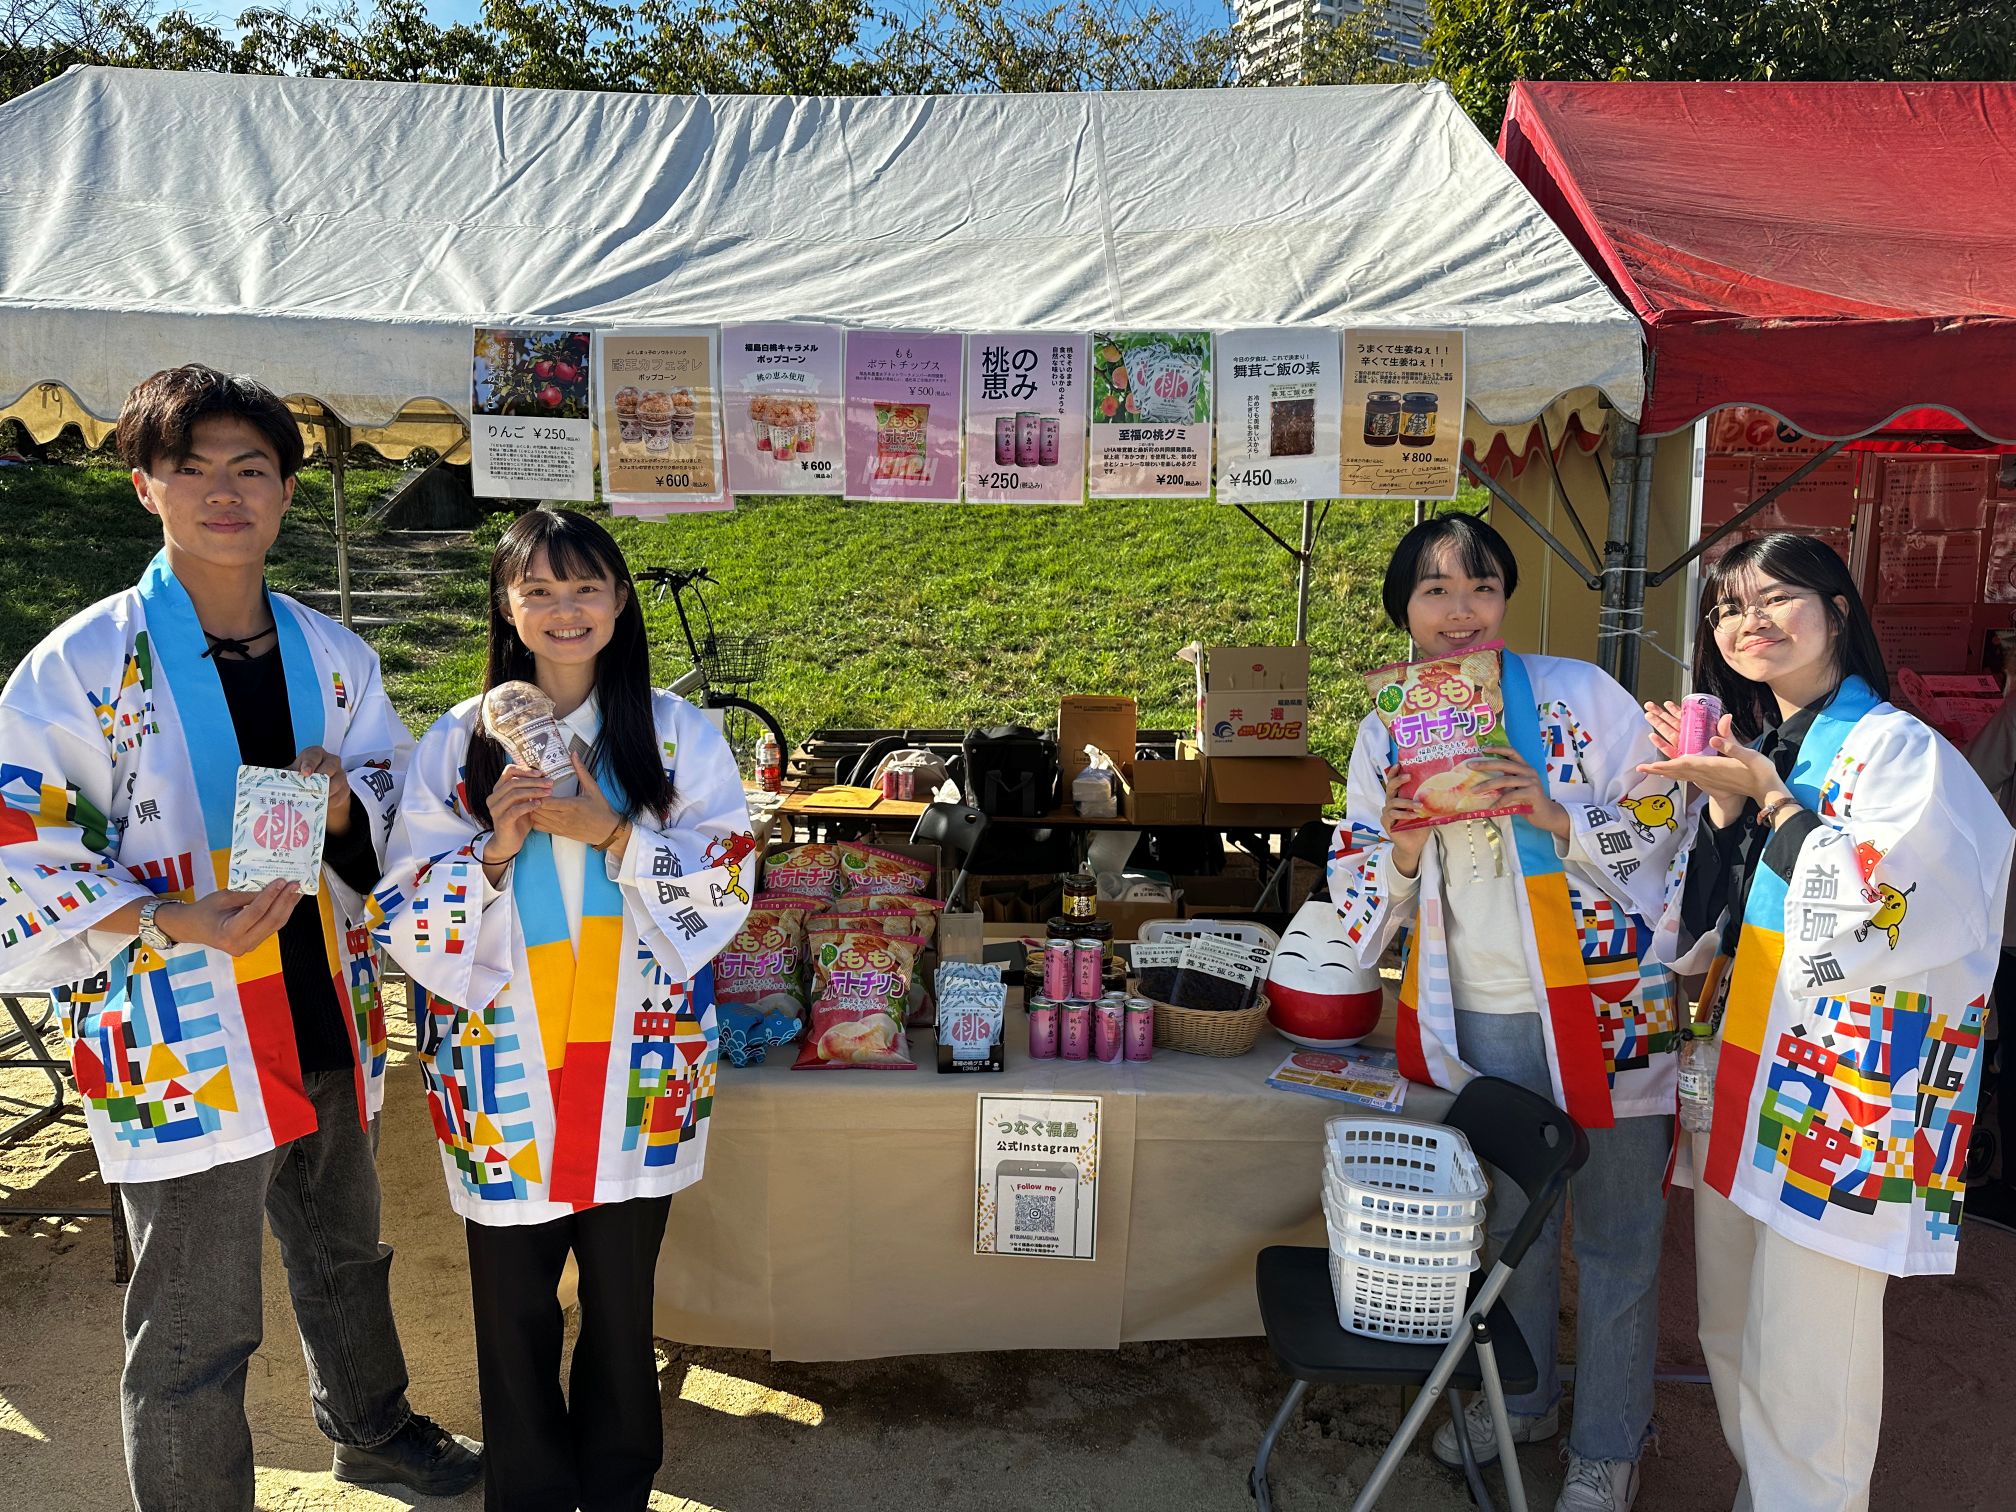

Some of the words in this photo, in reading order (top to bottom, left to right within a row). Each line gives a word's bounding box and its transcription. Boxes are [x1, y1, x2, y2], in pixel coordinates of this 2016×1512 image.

[744, 343, 819, 352] 福島白桃キャラメル
[895, 348, 913, 358] もも
[611, 358, 703, 372] 酪王カフェオレ
[757, 355, 806, 364] ポップコーン
[867, 360, 940, 370] ポテトチップス
[982, 346, 1038, 373] 桃の
[638, 373, 677, 381] ポップコーン
[756, 371, 805, 383] 桃の恵み使用
[1233, 361, 1321, 379] 舞茸ご飯の素
[981, 373, 1038, 400] 恵み
[1058, 347, 1066, 414] 食べているかのような
[909, 386, 934, 396] ¥500
[488, 425, 525, 439] りんご
[533, 427, 566, 440] ¥250
[1118, 428, 1187, 441] 至福の桃グミ
[1402, 452, 1432, 462] ¥800
[801, 461, 832, 471] ¥600
[655, 474, 689, 487] ¥600
[978, 473, 1019, 489] ¥250
[1156, 474, 1184, 486] ¥200
[1230, 469, 1272, 487] ¥450
[1405, 679, 1473, 711] もも
[1256, 721, 1303, 740] りんご
[259, 796, 310, 808] 至福の桃グミ
[134, 798, 161, 825] 県
[788, 851, 840, 869] もも
[1799, 863, 1845, 989] 福島県
[735, 929, 784, 952] もも
[840, 948, 893, 969] もも
[997, 1120, 1079, 1138] つなぐ福島
[996, 1140, 1080, 1155] 公式Instagram
[1016, 1183, 1042, 1191] Follow
